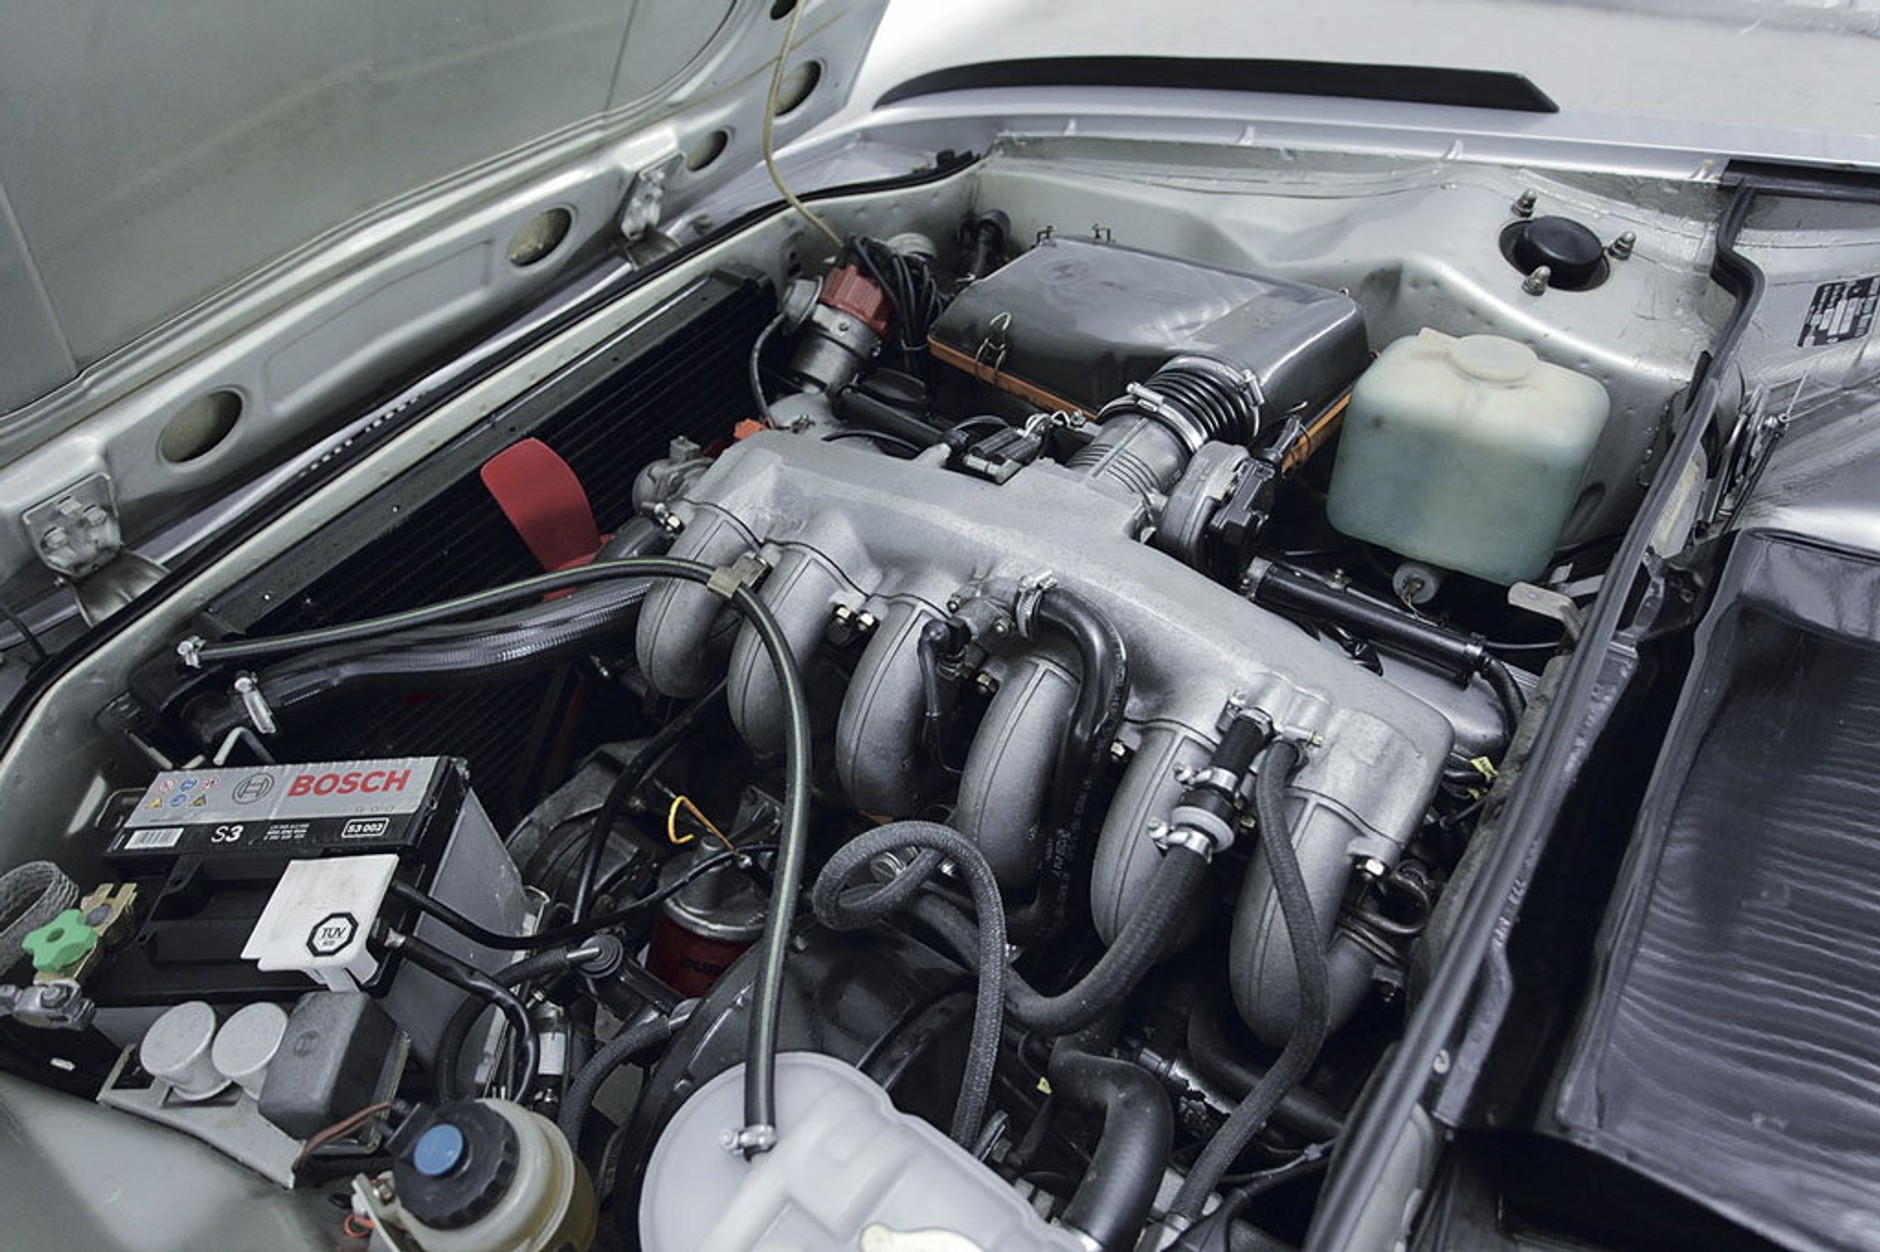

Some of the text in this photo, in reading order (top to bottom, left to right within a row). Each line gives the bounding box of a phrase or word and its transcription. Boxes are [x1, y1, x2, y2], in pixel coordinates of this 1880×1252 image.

[288, 769, 411, 797] BOSCH
[211, 824, 244, 843] S3
[347, 823, 362, 833] S3
